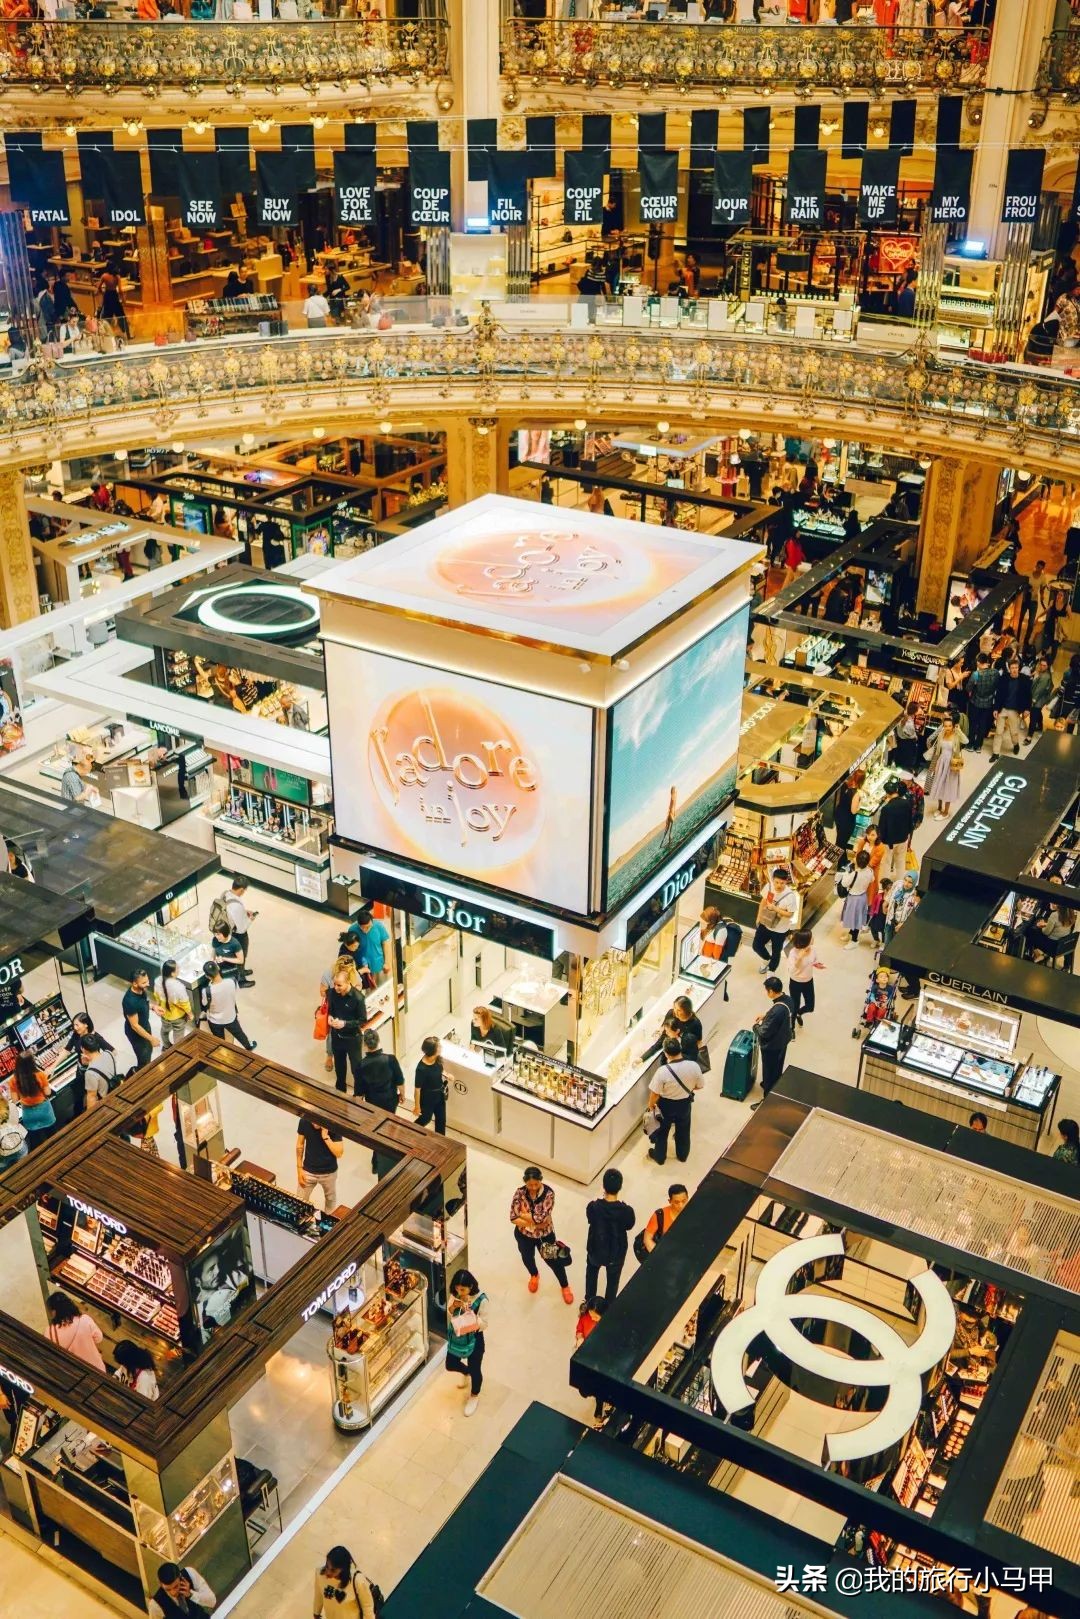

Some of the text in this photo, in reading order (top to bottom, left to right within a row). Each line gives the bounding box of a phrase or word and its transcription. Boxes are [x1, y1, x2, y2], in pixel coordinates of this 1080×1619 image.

[339, 187, 370, 199] LOVE
[413, 188, 448, 200] COUP
[566, 188, 601, 200] COUP
[862, 185, 896, 197] WAKE
[189, 200, 213, 211] SEE
[264, 198, 289, 210] BUY
[343, 198, 368, 210] FOR
[422, 199, 440, 211] DE
[497, 198, 516, 210] FIL
[575, 199, 593, 210] DE
[640, 196, 678, 208] CŒUR
[714, 199, 748, 210] JOUR
[793, 196, 818, 208] THE
[868, 196, 886, 208] ME
[941, 197, 962, 208] MY
[1006, 195, 1037, 207] FROU
[31, 209, 68, 222] FATAL
[111, 210, 141, 222] IDOL
[187, 211, 216, 223] NOW
[262, 209, 291, 221] NOW
[340, 209, 372, 221] SALE
[411, 210, 450, 222] CŒUR
[491, 209, 523, 221] NOIR
[574, 209, 593, 221] FIL
[643, 207, 675, 219] NOIR
[727, 209, 735, 221] J
[790, 207, 820, 219] RAIN
[867, 207, 885, 219] UP
[934, 207, 966, 219] HERO
[1004, 206, 1036, 218] FROU
[957, 775, 1028, 850] GUERLAIN
[662, 863, 696, 910] Dior
[421, 892, 486, 934] Dior
[928, 972, 1008, 1004] GUERLAIN
[66, 1194, 127, 1234] TOM FORD
[301, 1262, 357, 1321] TOM FORD
[0, 1364, 35, 1394] FORD
